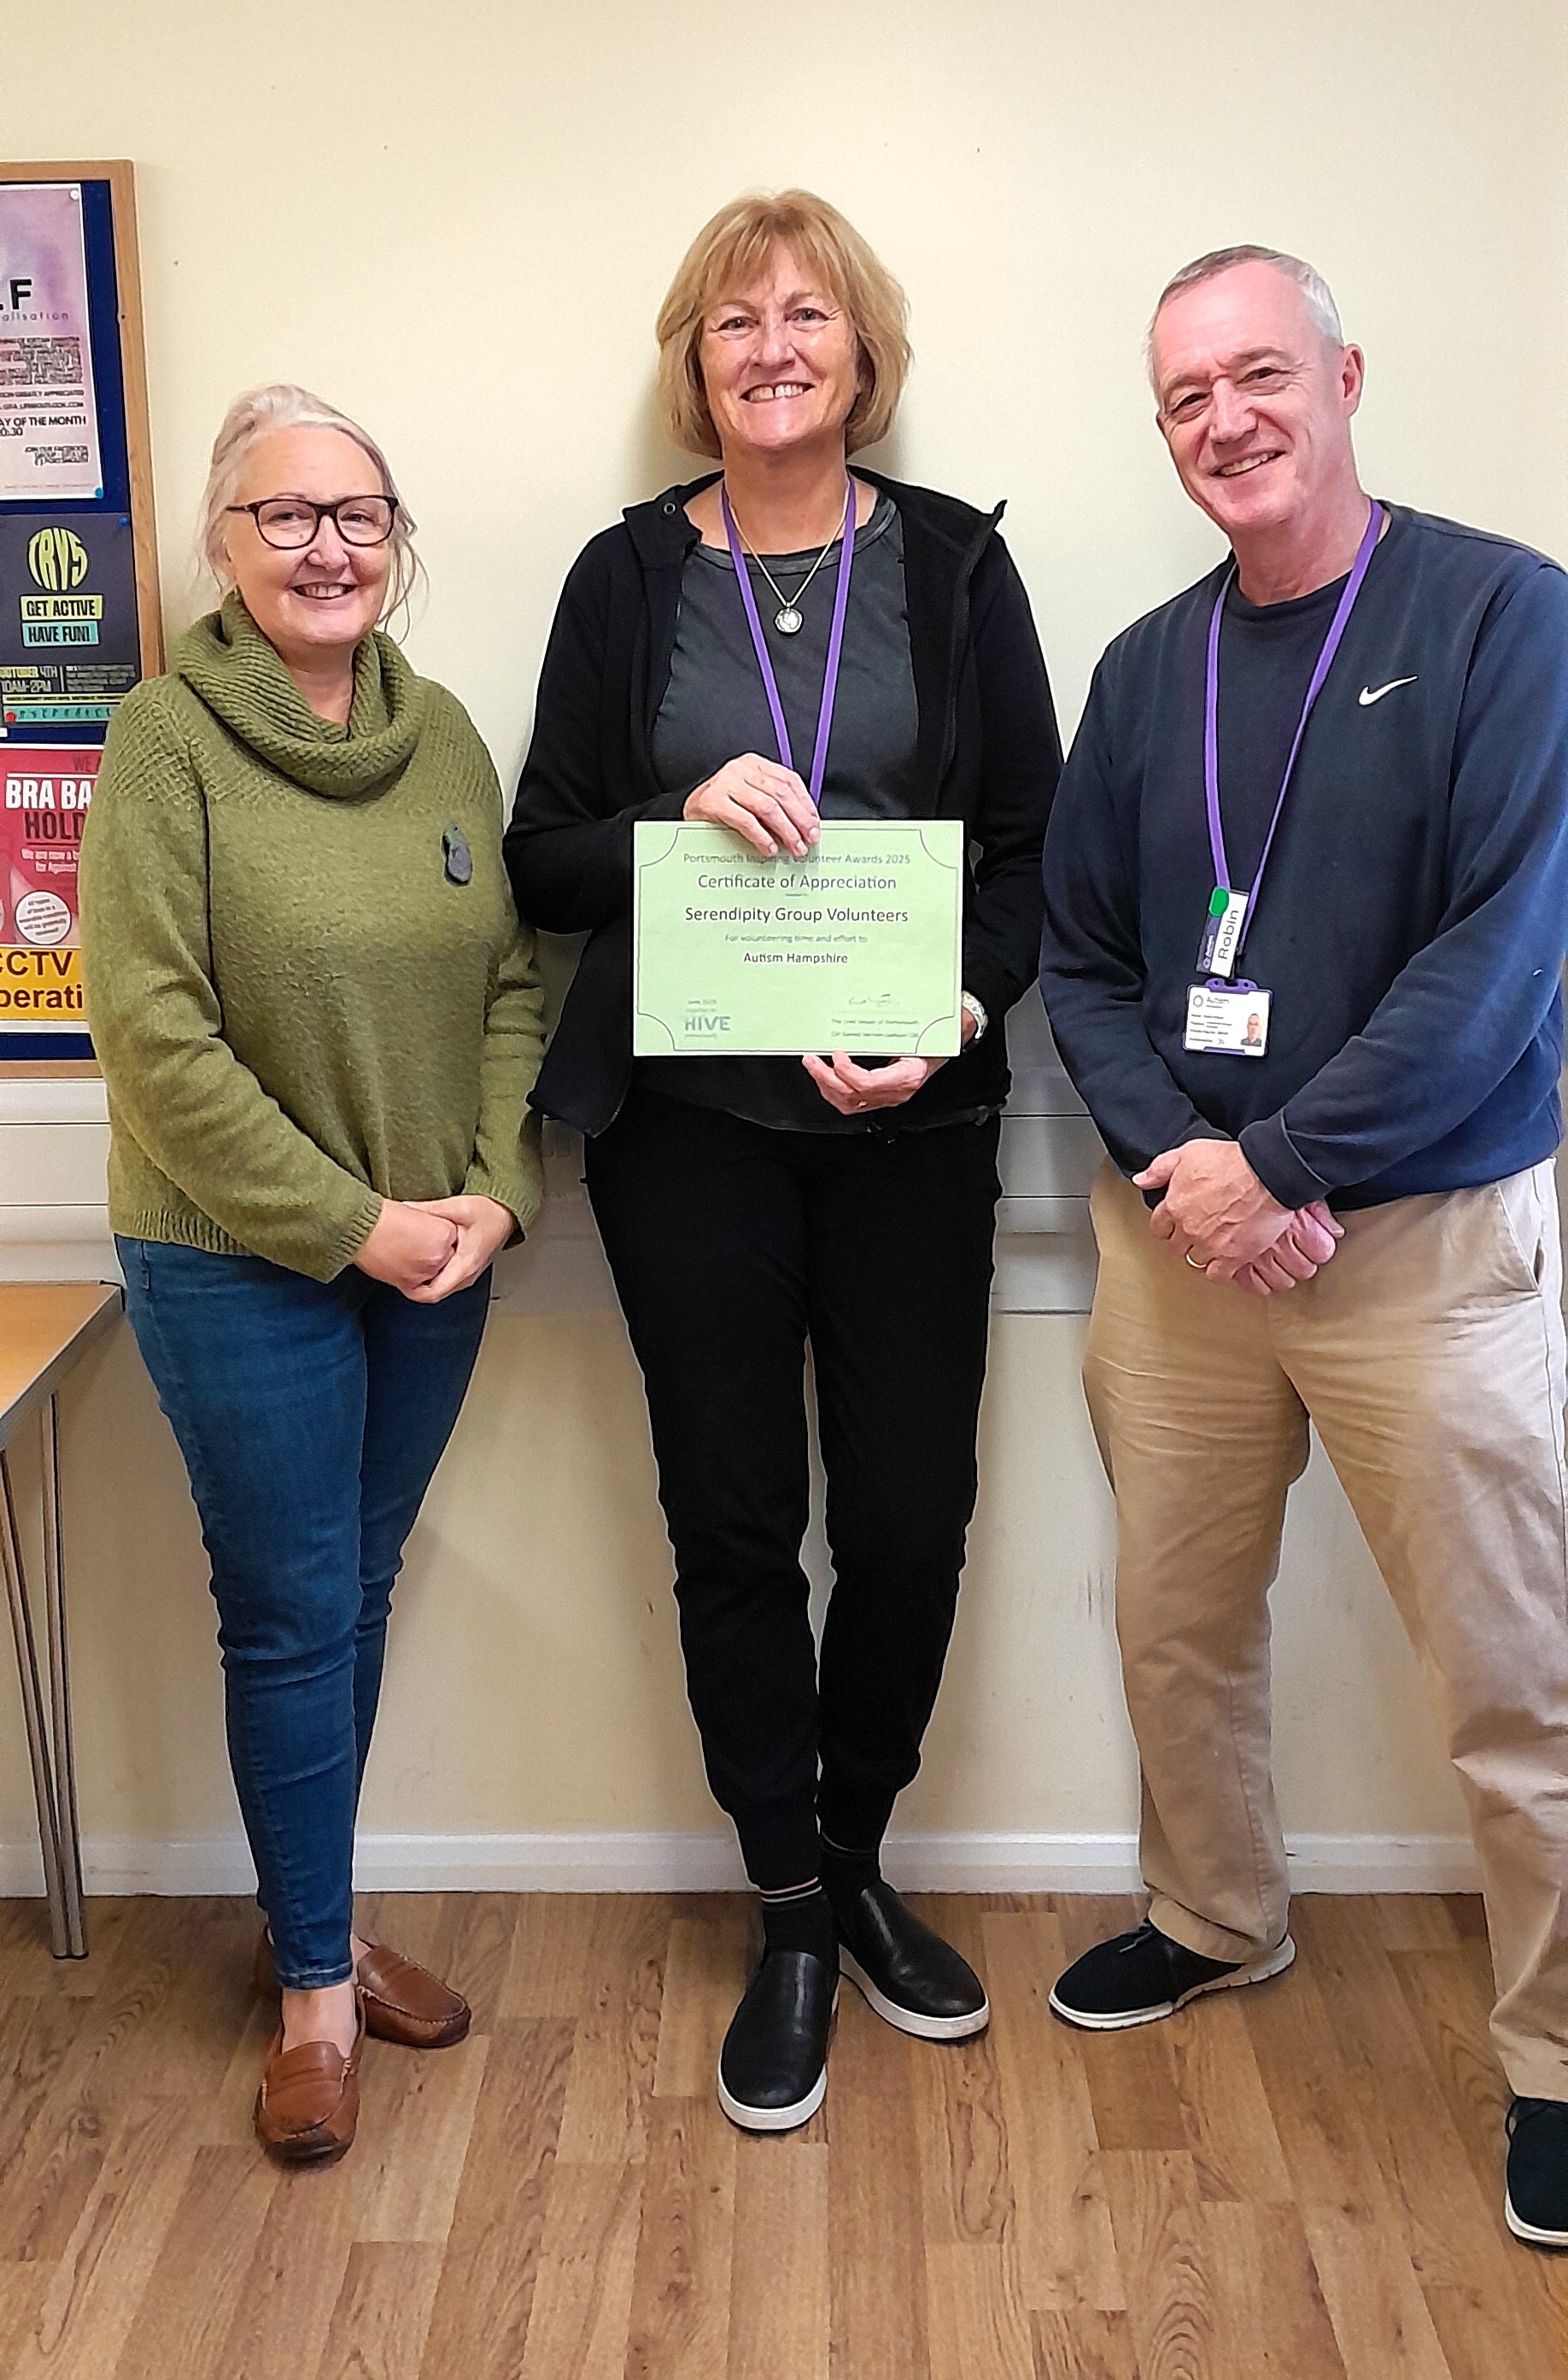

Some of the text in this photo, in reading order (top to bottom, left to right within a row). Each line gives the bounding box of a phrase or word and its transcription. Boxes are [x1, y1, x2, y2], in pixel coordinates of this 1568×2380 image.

[13, 417, 26, 426] OF
[28, 417, 47, 425] THE
[49, 415, 86, 425] MONTH
[26, 599, 96, 617] GET ACTIVE
[28, 626, 60, 642] HAVE
[2, 679, 52, 693] 10AM-2PM
[5, 779, 92, 810] BRA BA
[683, 853, 743, 863] Portsmouth
[845, 854, 883, 864] Awards
[886, 854, 911, 864] 2025
[698, 874, 897, 892] Certificate of Appreciation
[685, 907, 909, 924] Serendipity Group Volunteers
[740, 933, 793, 944] volunteering
[815, 933, 832, 943] and
[1218, 909, 1239, 960] Robin
[0, 950, 73, 976] CTV
[743, 952, 848, 965] Autism Hampshire
[684, 1016, 731, 1032] HIVE
